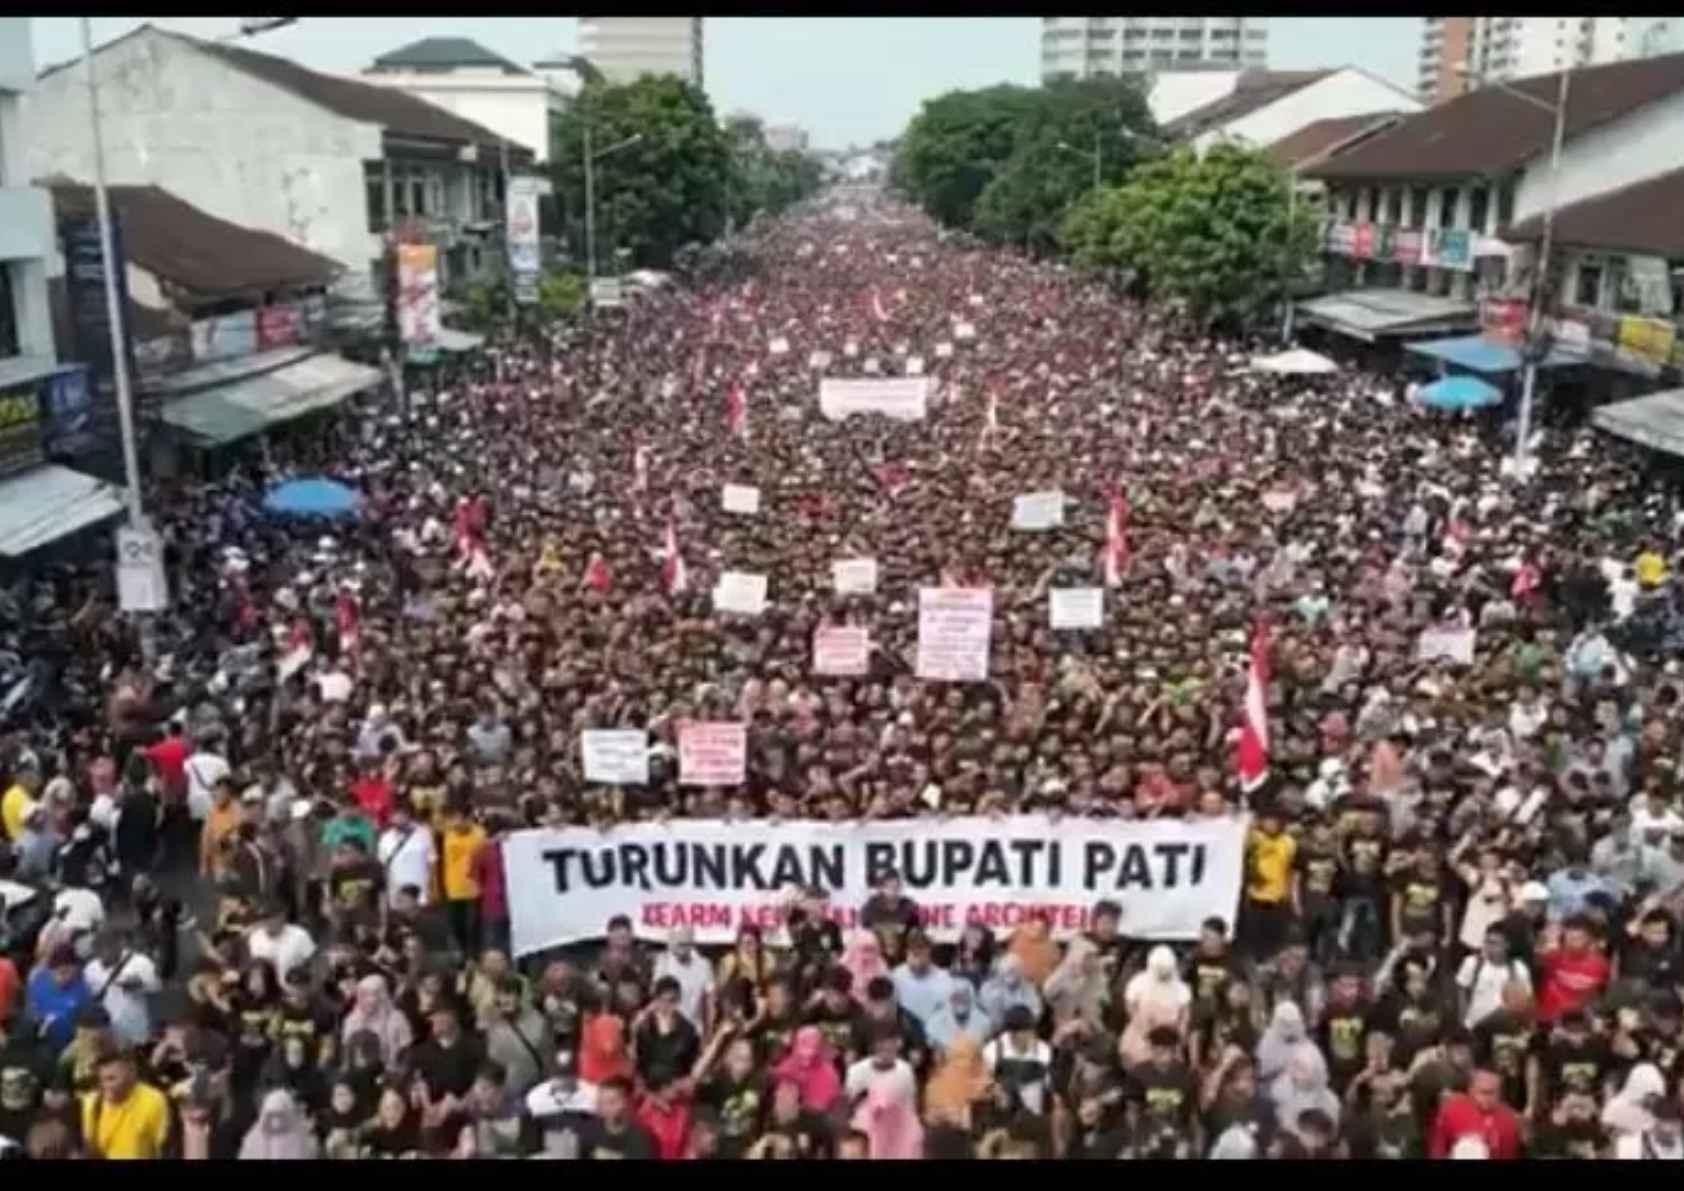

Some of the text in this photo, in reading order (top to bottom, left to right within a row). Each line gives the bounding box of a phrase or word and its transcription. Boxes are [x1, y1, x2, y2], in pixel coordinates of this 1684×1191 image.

[542, 839, 1206, 894] TURUNKAN BUPATI PATI
